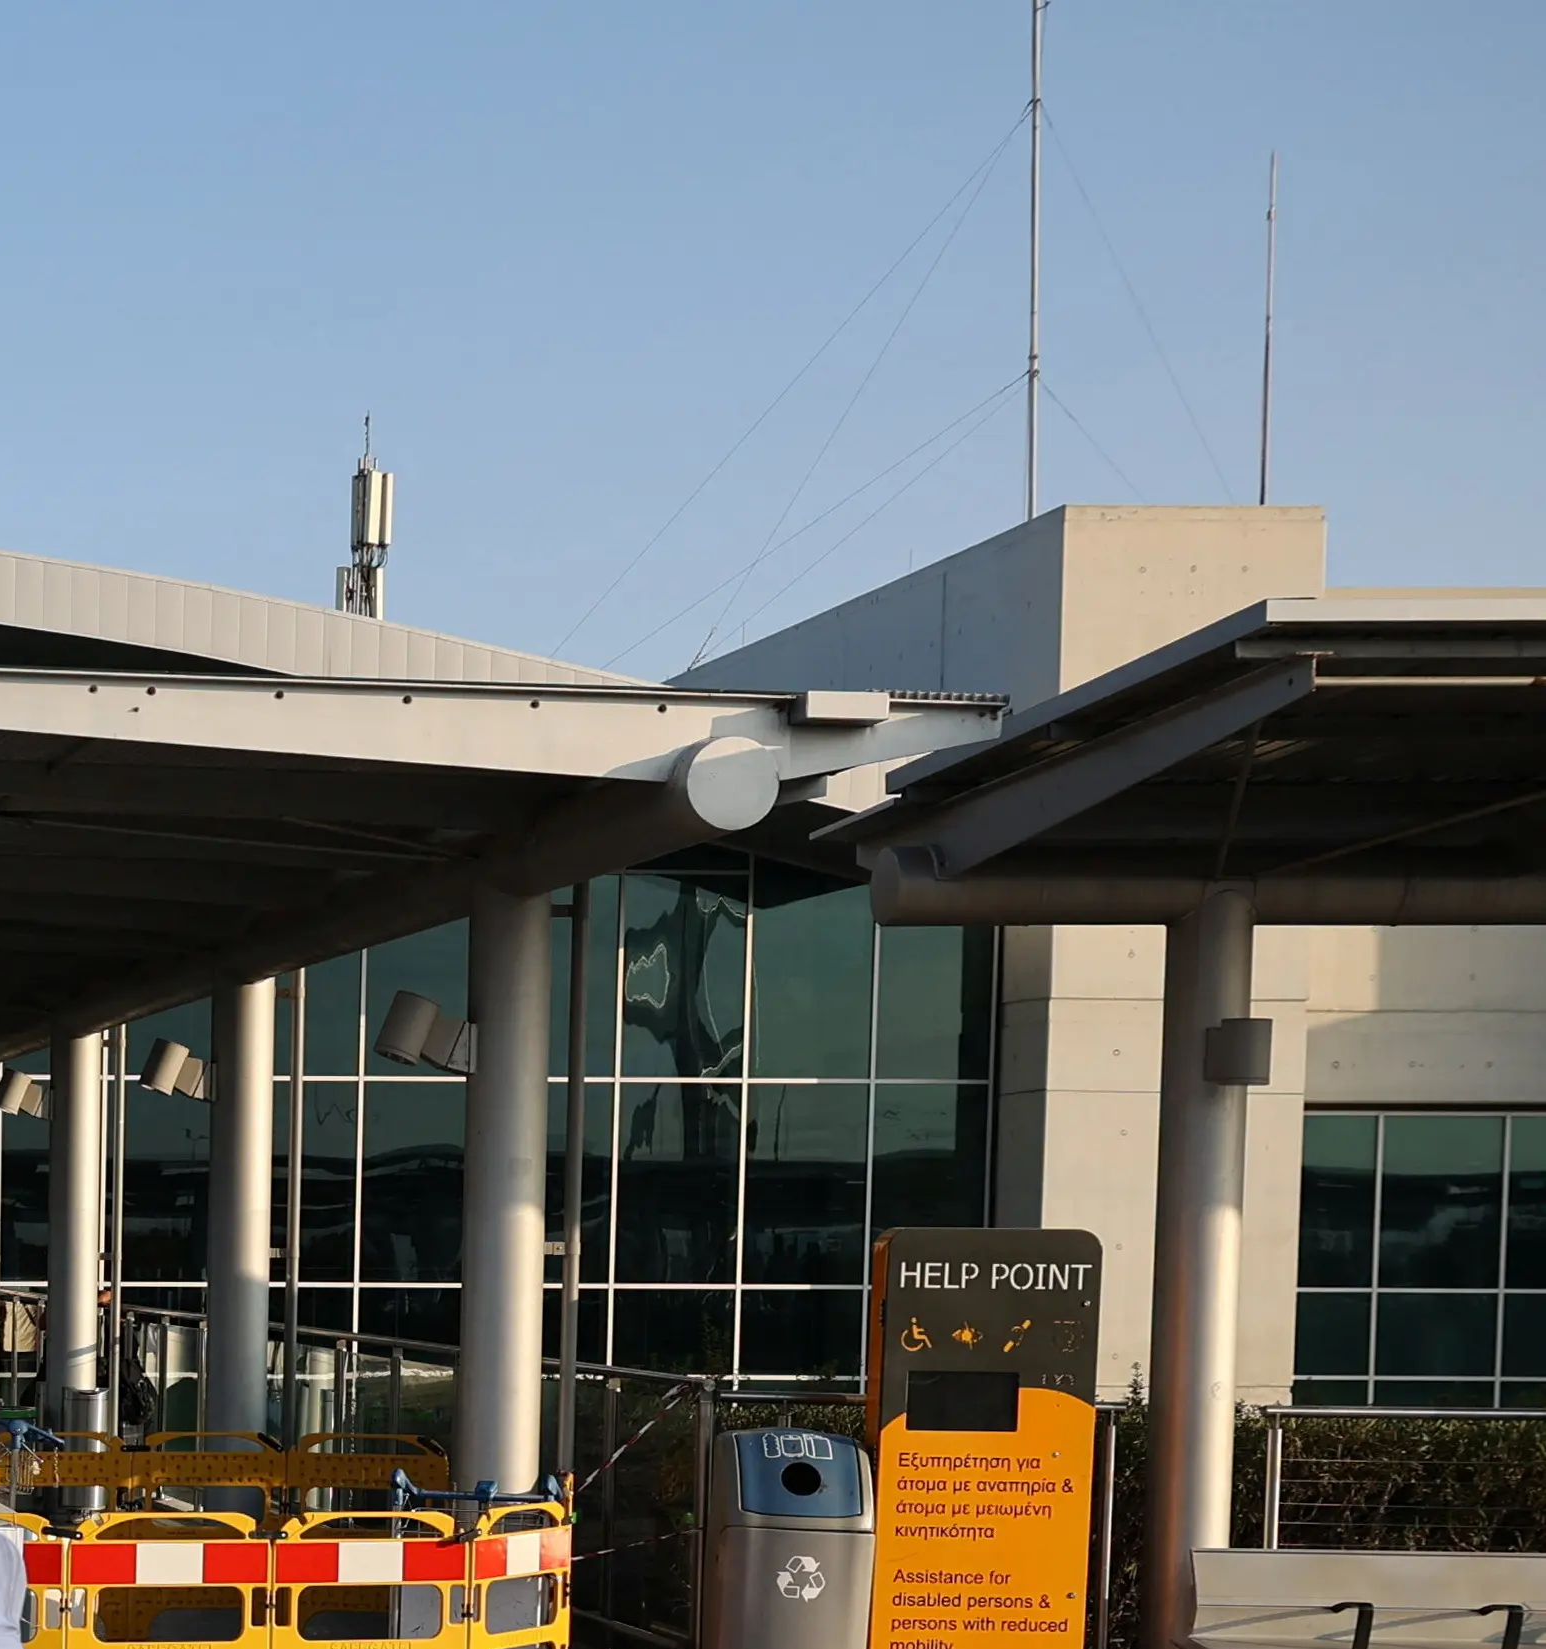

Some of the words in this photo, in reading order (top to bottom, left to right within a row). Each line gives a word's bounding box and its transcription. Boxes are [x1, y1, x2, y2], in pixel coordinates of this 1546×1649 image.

[899, 1261, 980, 1289] HELP
[991, 1263, 1093, 1291] POINT
[898, 1452, 1012, 1470] Εξυπηρέτηση
[1016, 1456, 1041, 1472] για
[897, 1476, 948, 1495] άτομα
[953, 1480, 971, 1494] με
[976, 1477, 1057, 1495] αναπηρία
[1061, 1478, 1074, 1494] &
[896, 1500, 947, 1518] άτομα
[951, 1503, 970, 1517] με
[975, 1501, 1053, 1518] μειωμένη
[894, 1523, 995, 1542] κινητικότητα
[893, 1568, 984, 1585] Assistance
[989, 1569, 1012, 1585] for
[892, 1591, 962, 1608] disabled
[966, 1595, 1034, 1610] persons
[1039, 1594, 1051, 1609] &
[890, 1616, 958, 1632] persons
[962, 1616, 996, 1632] with
[1000, 1617, 1069, 1633] reduced
